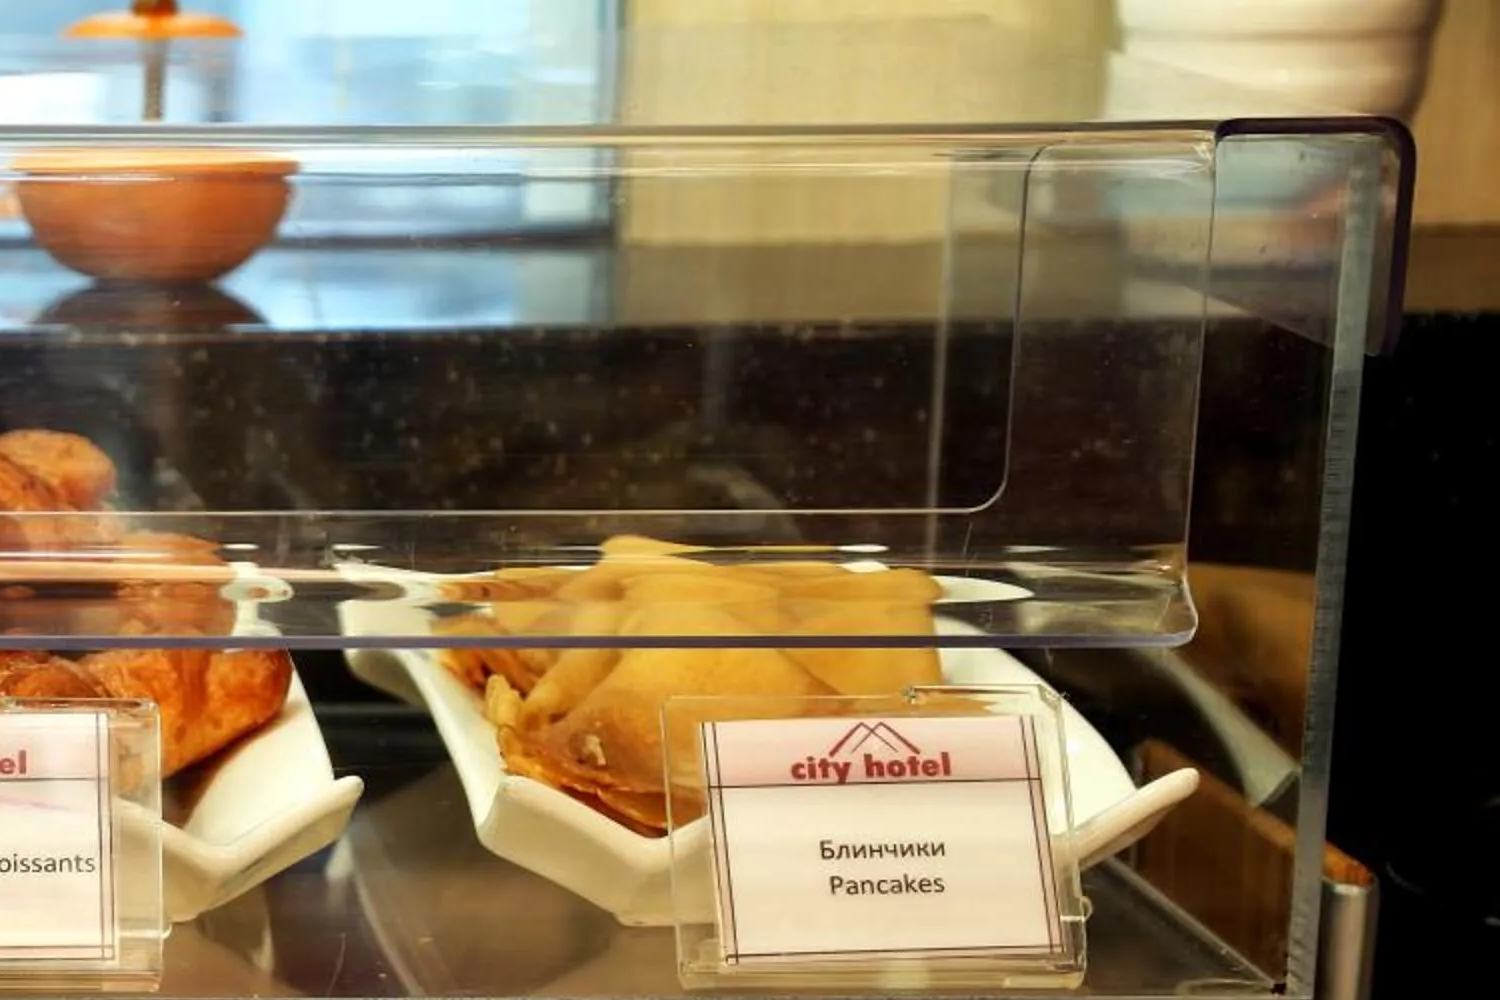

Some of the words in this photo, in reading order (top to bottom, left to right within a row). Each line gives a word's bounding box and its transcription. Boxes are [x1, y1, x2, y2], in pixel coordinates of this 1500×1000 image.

[790, 756, 852, 783] city
[864, 752, 952, 778] hotel
[819, 840, 946, 860] Блинчики
[830, 874, 946, 895] Pancakes
